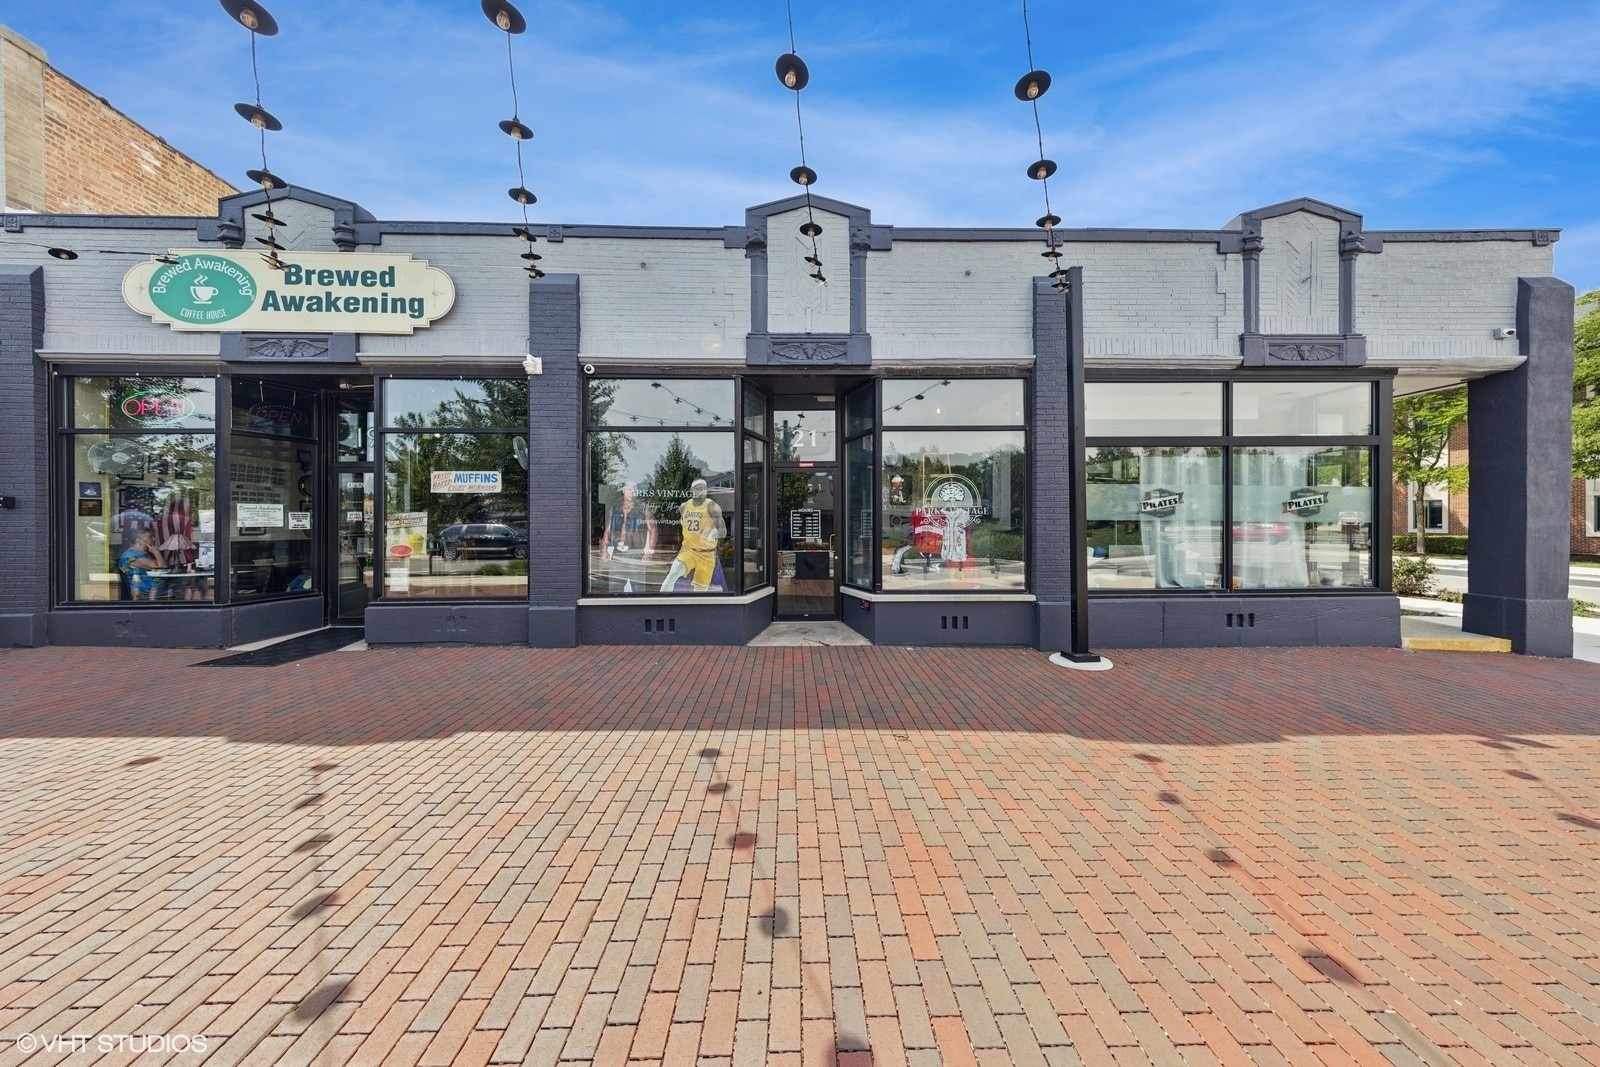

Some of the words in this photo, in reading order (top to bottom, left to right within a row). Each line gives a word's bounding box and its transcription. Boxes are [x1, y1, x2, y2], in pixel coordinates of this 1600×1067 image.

[152, 258, 192, 294] Brewed
[194, 257, 253, 296] Awakening
[284, 263, 396, 288] Brewed
[260, 289, 425, 319] Awakening
[180, 307, 204, 320] COFFEE
[206, 308, 228, 319] HOUSE
[124, 398, 185, 417] OPEN
[256, 408, 302, 424] OPEN
[791, 429, 816, 447] 21
[454, 473, 498, 483] MUFFINS
[625, 489, 655, 497] ARKS
[657, 490, 699, 498] VINTAGE
[1142, 498, 1178, 510] PILATES
[1287, 497, 1323, 509] PILATES
[915, 508, 945, 516] PARK
[687, 520, 699, 531] 23
